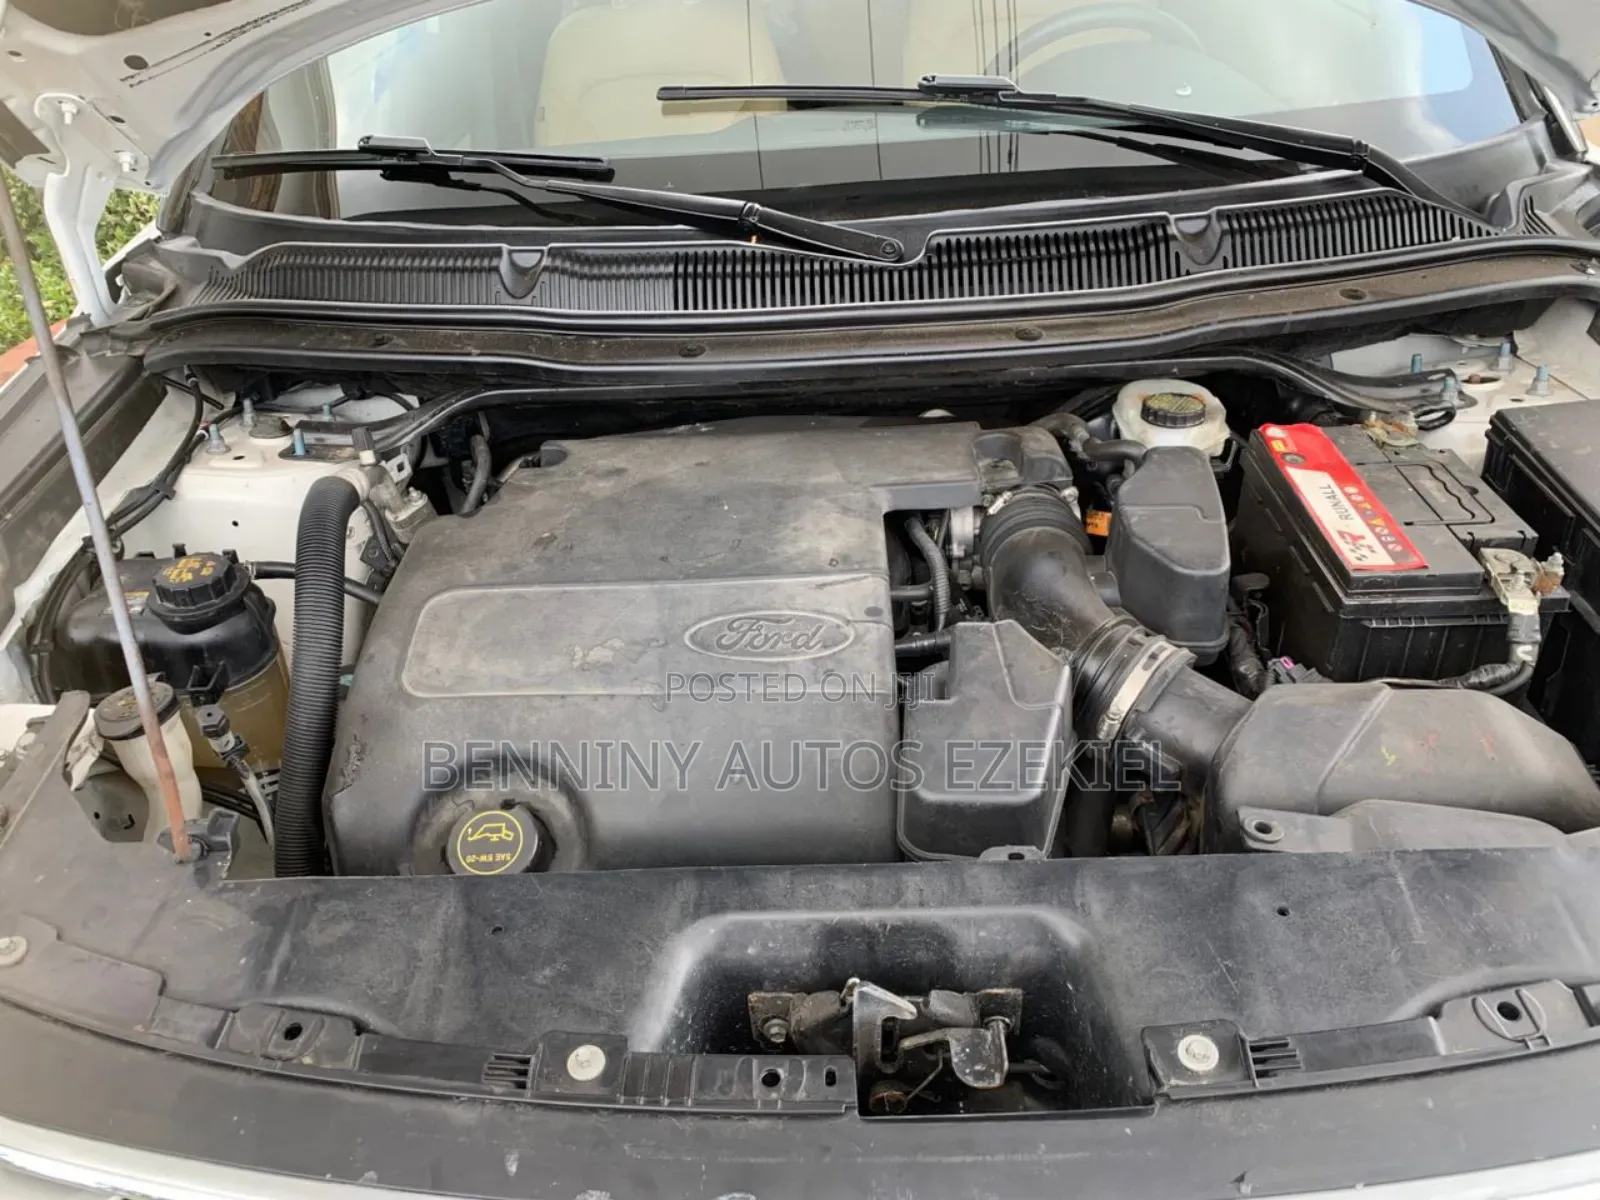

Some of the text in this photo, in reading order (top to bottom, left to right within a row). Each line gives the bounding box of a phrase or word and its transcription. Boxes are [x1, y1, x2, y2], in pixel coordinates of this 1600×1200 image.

[1319, 484, 1355, 520] RUNALL
[716, 616, 826, 651] Ford
[465, 852, 511, 864] SAE 5W-20
